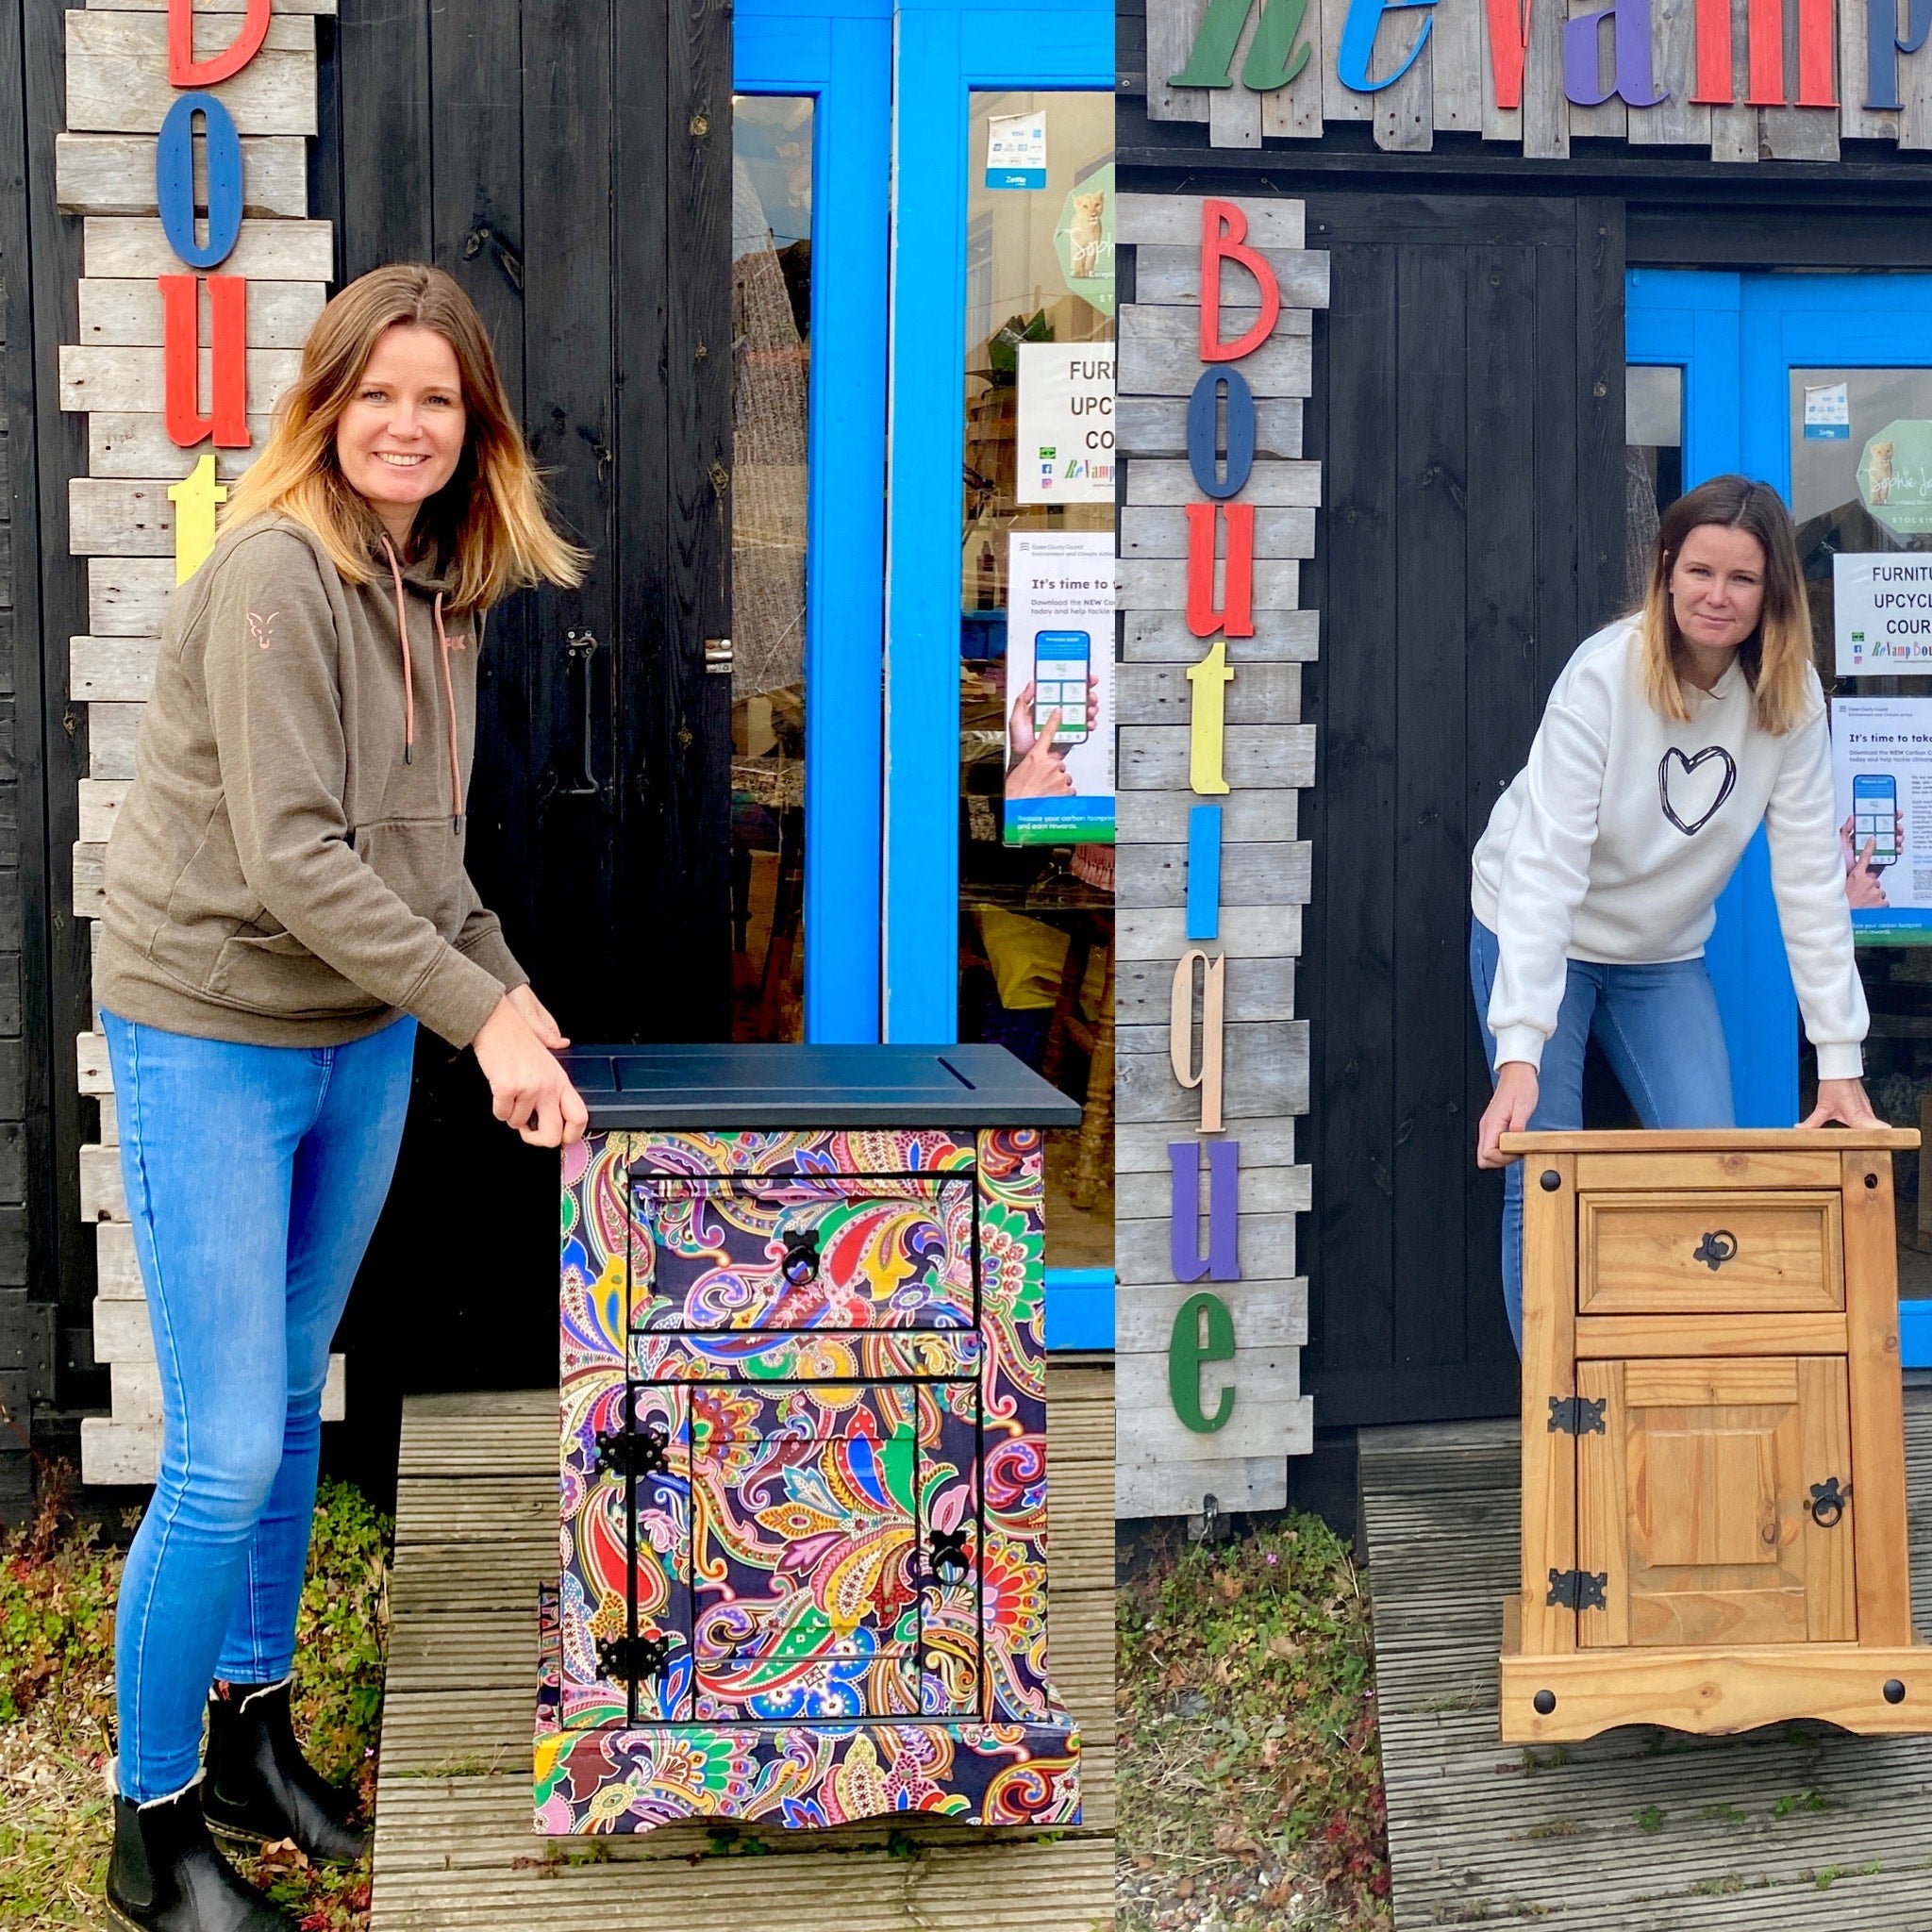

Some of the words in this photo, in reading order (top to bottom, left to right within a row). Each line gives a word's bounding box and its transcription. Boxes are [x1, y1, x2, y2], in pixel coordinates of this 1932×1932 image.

[1070, 360, 1115, 380] FUR
[1071, 396, 1115, 416] UPC
[1086, 430, 1115, 450] CO
[1032, 578, 1056, 590] It's
[1059, 577, 1091, 590] time
[1094, 579, 1108, 590] to
[1887, 619, 1931, 635] COUR
[1850, 734, 1867, 742] It's
[1871, 733, 1894, 742] time
[1898, 734, 1907, 742] to
[1168, 199, 1280, 1434] Boutique
